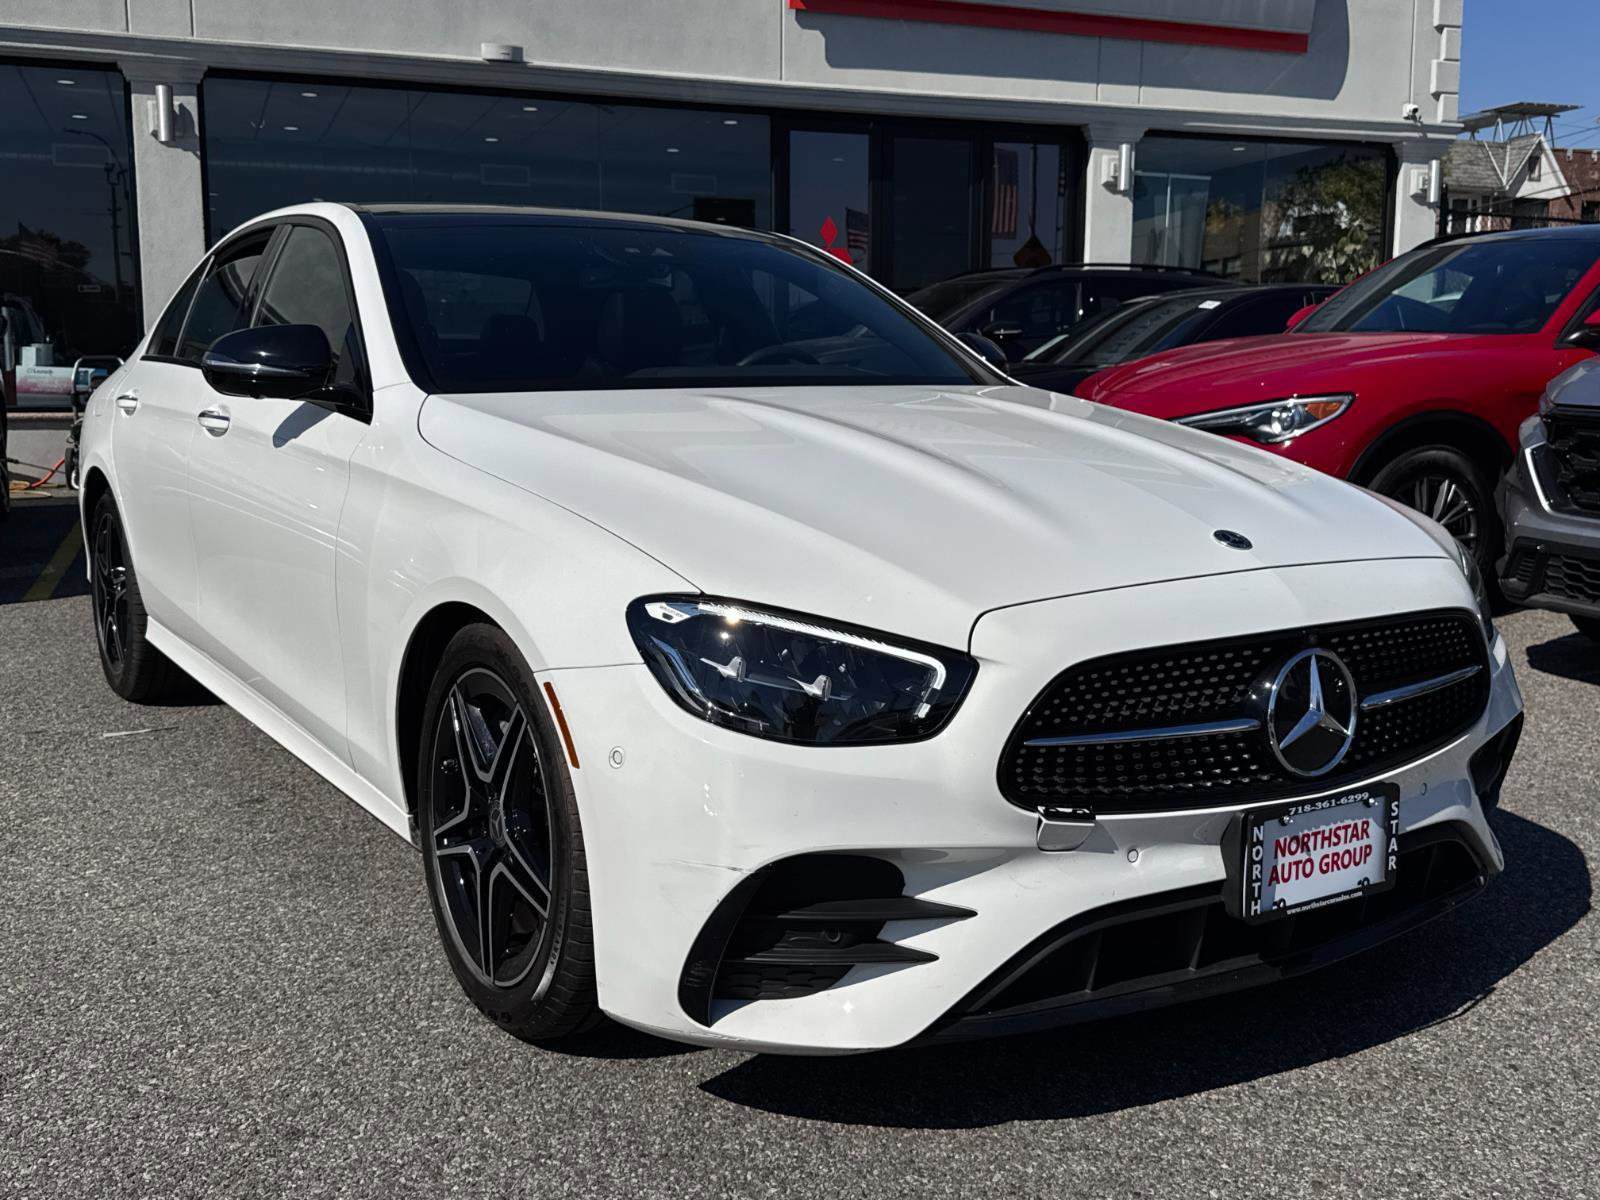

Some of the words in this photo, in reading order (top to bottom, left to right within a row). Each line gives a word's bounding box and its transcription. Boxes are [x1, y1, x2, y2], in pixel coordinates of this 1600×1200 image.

[1288, 792, 1370, 816] 718-361-6299
[1274, 819, 1370, 859] NORTHSTAR
[1387, 800, 1400, 871] STAR
[1250, 825, 1264, 917] NORTH
[1267, 857, 1315, 887] AUTO
[1318, 843, 1373, 875] GROUP
